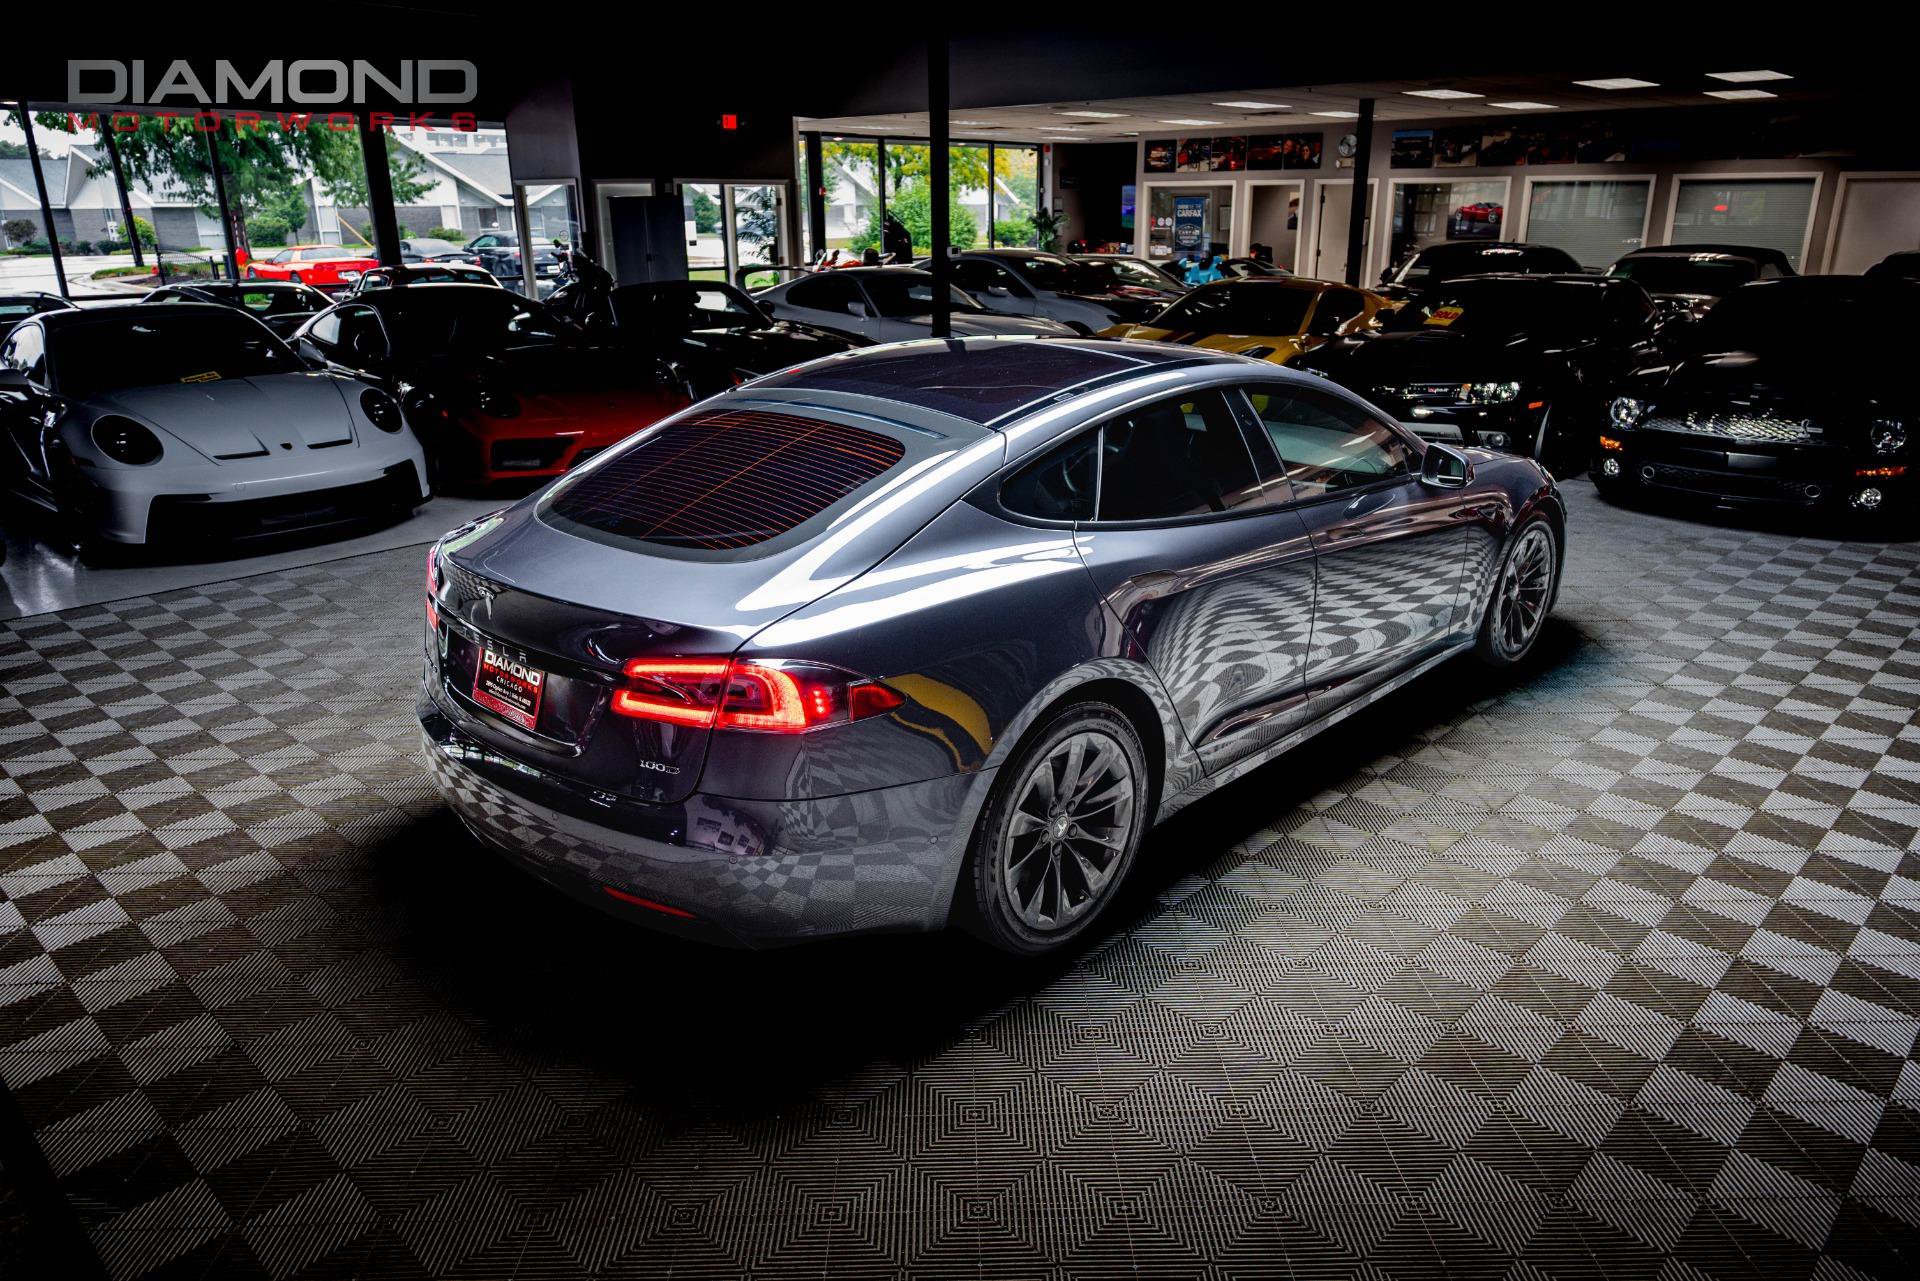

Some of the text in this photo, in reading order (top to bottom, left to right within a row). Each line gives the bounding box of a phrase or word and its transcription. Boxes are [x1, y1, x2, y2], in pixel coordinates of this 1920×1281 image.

[1177, 209, 1202, 217] CARFAX
[461, 626, 527, 664] TESLA
[483, 663, 538, 693] MOTORWORKS
[484, 649, 541, 687] DIAMOND
[496, 675, 523, 693] CHICAGO
[639, 759, 681, 775] 100D
